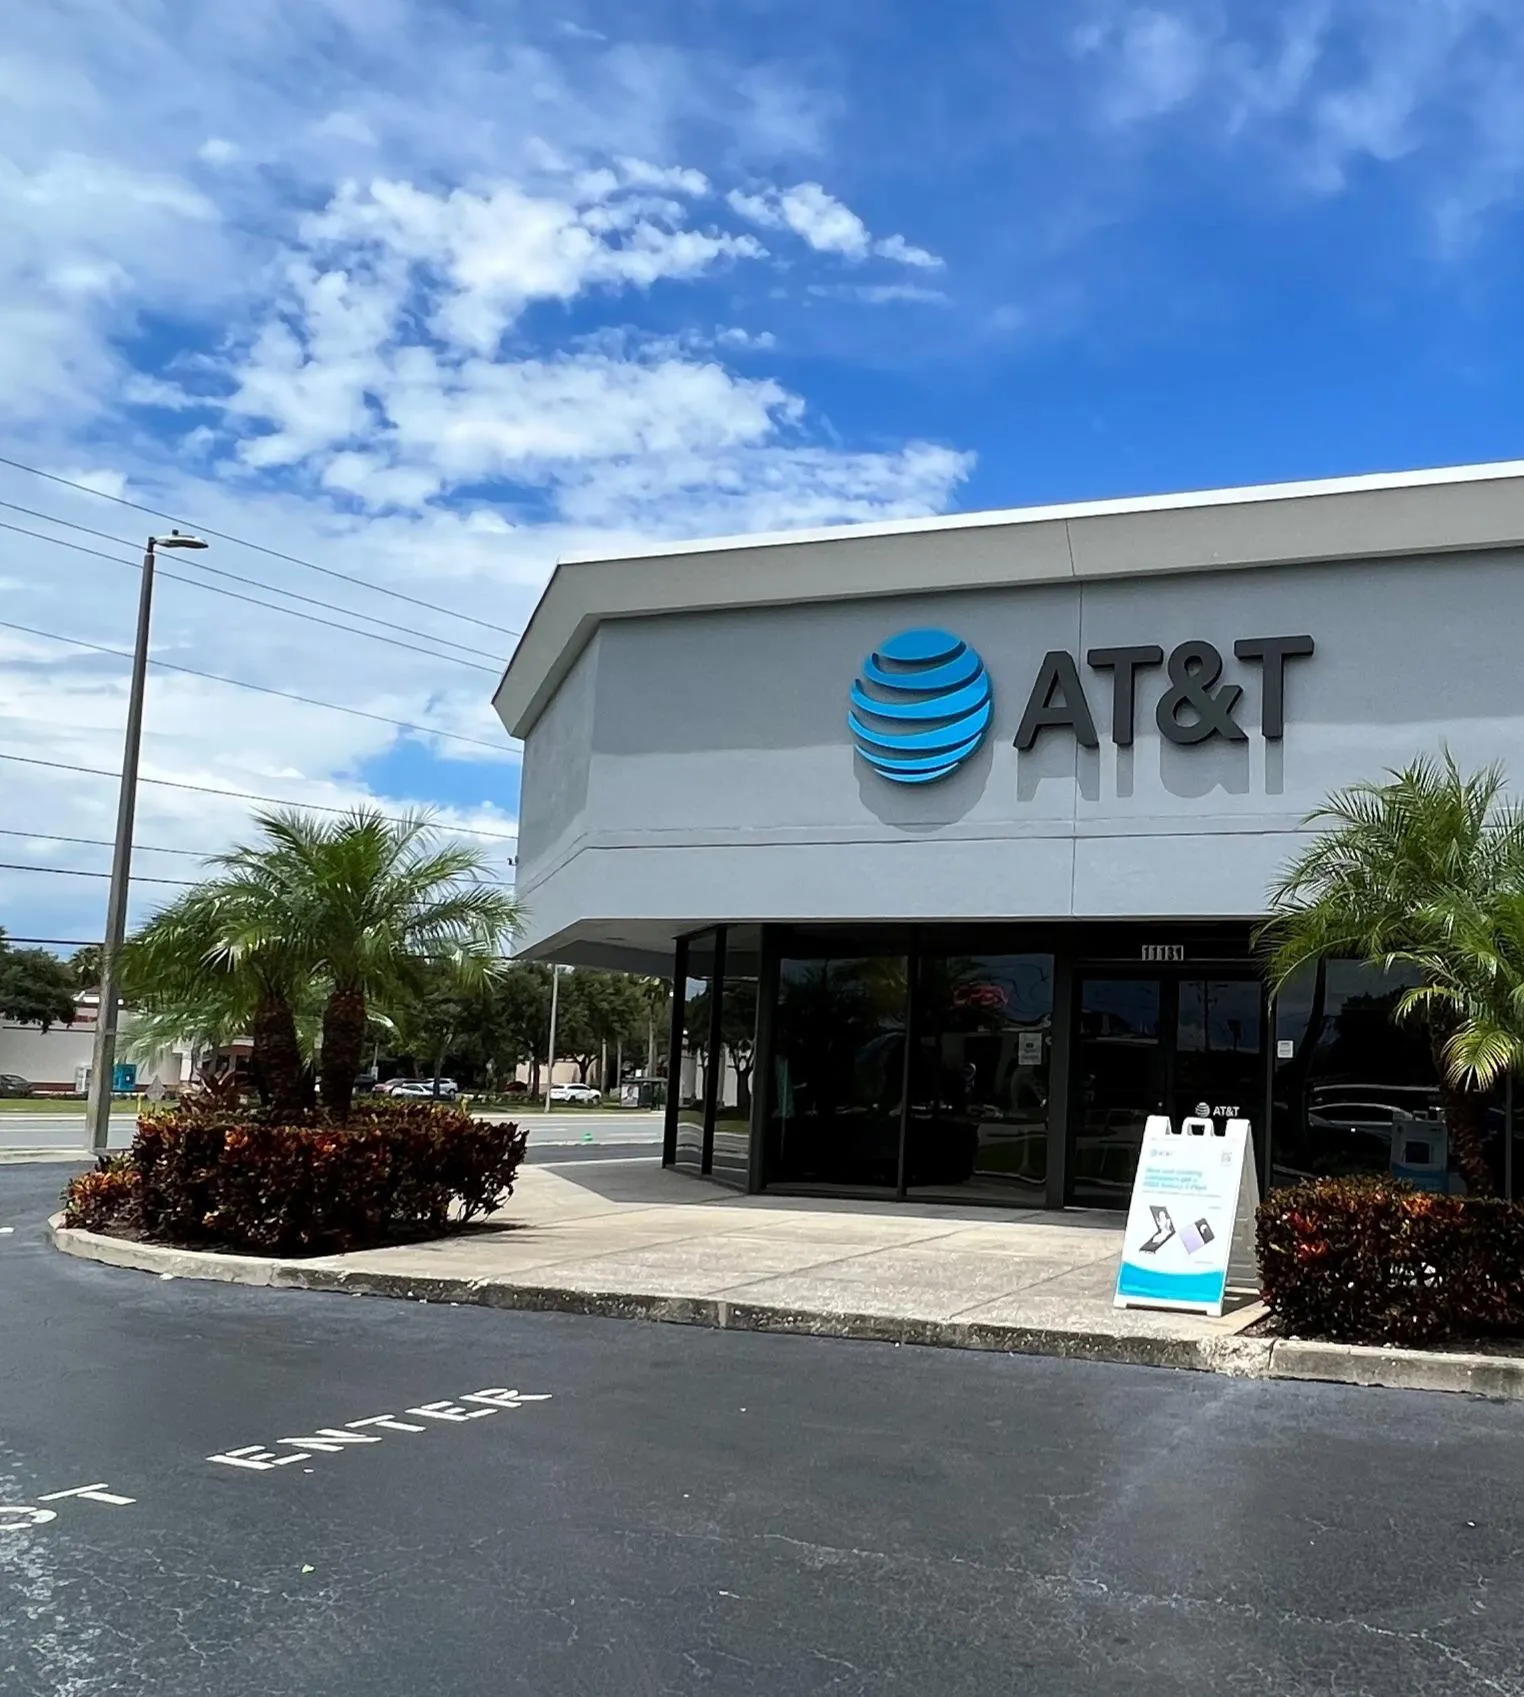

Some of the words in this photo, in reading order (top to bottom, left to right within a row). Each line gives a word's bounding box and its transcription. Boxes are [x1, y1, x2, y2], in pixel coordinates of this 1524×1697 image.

[1013, 635, 1314, 750] AT&T
[1213, 1106, 1240, 1117] AT&T
[206, 1388, 552, 1470] ENTER
